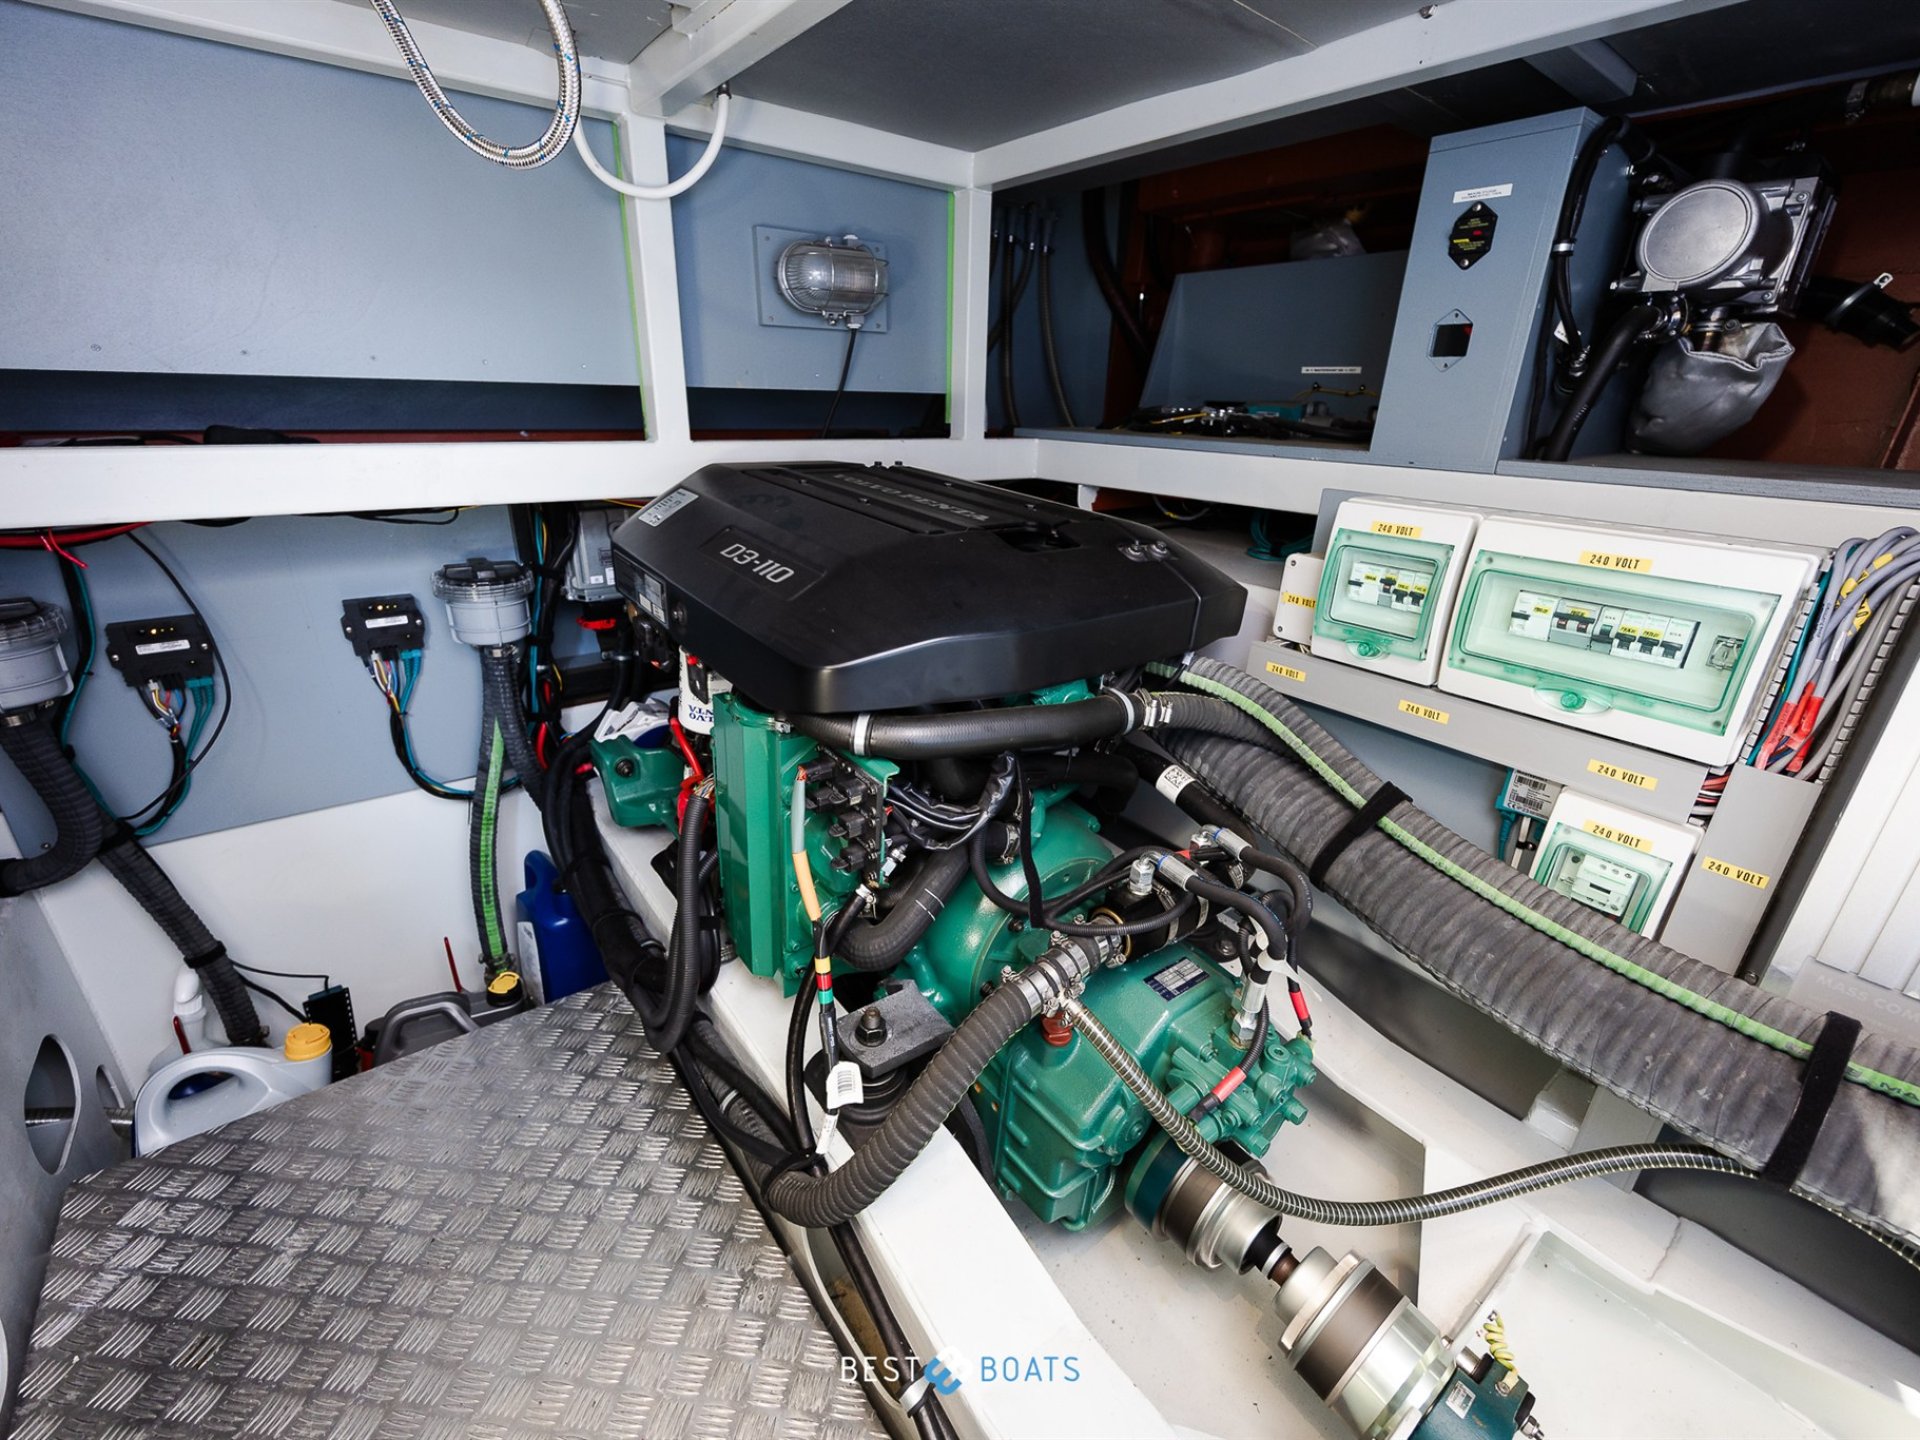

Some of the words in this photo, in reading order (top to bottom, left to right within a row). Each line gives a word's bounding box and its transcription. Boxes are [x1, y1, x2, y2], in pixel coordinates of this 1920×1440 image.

[900, 493, 989, 522] PENTA
[1378, 523, 1393, 534] 240
[1396, 526, 1414, 537] VOLT
[719, 543, 795, 584] D3-110
[1589, 554, 1610, 566] 240
[1615, 557, 1640, 570] VOLT
[1287, 595, 1299, 604] 240
[1302, 598, 1316, 608] VOLT
[1271, 664, 1283, 675] 240
[1285, 668, 1299, 679] VOLT
[1405, 703, 1420, 715] 240
[1423, 708, 1441, 721] VOLT
[1597, 764, 1617, 778] 240
[1621, 771, 1645, 786] VOLT
[1592, 824, 1612, 839] 240
[1617, 832, 1641, 848] VOLT
[1708, 861, 1730, 876] 240
[1736, 870, 1764, 886] VOLT
